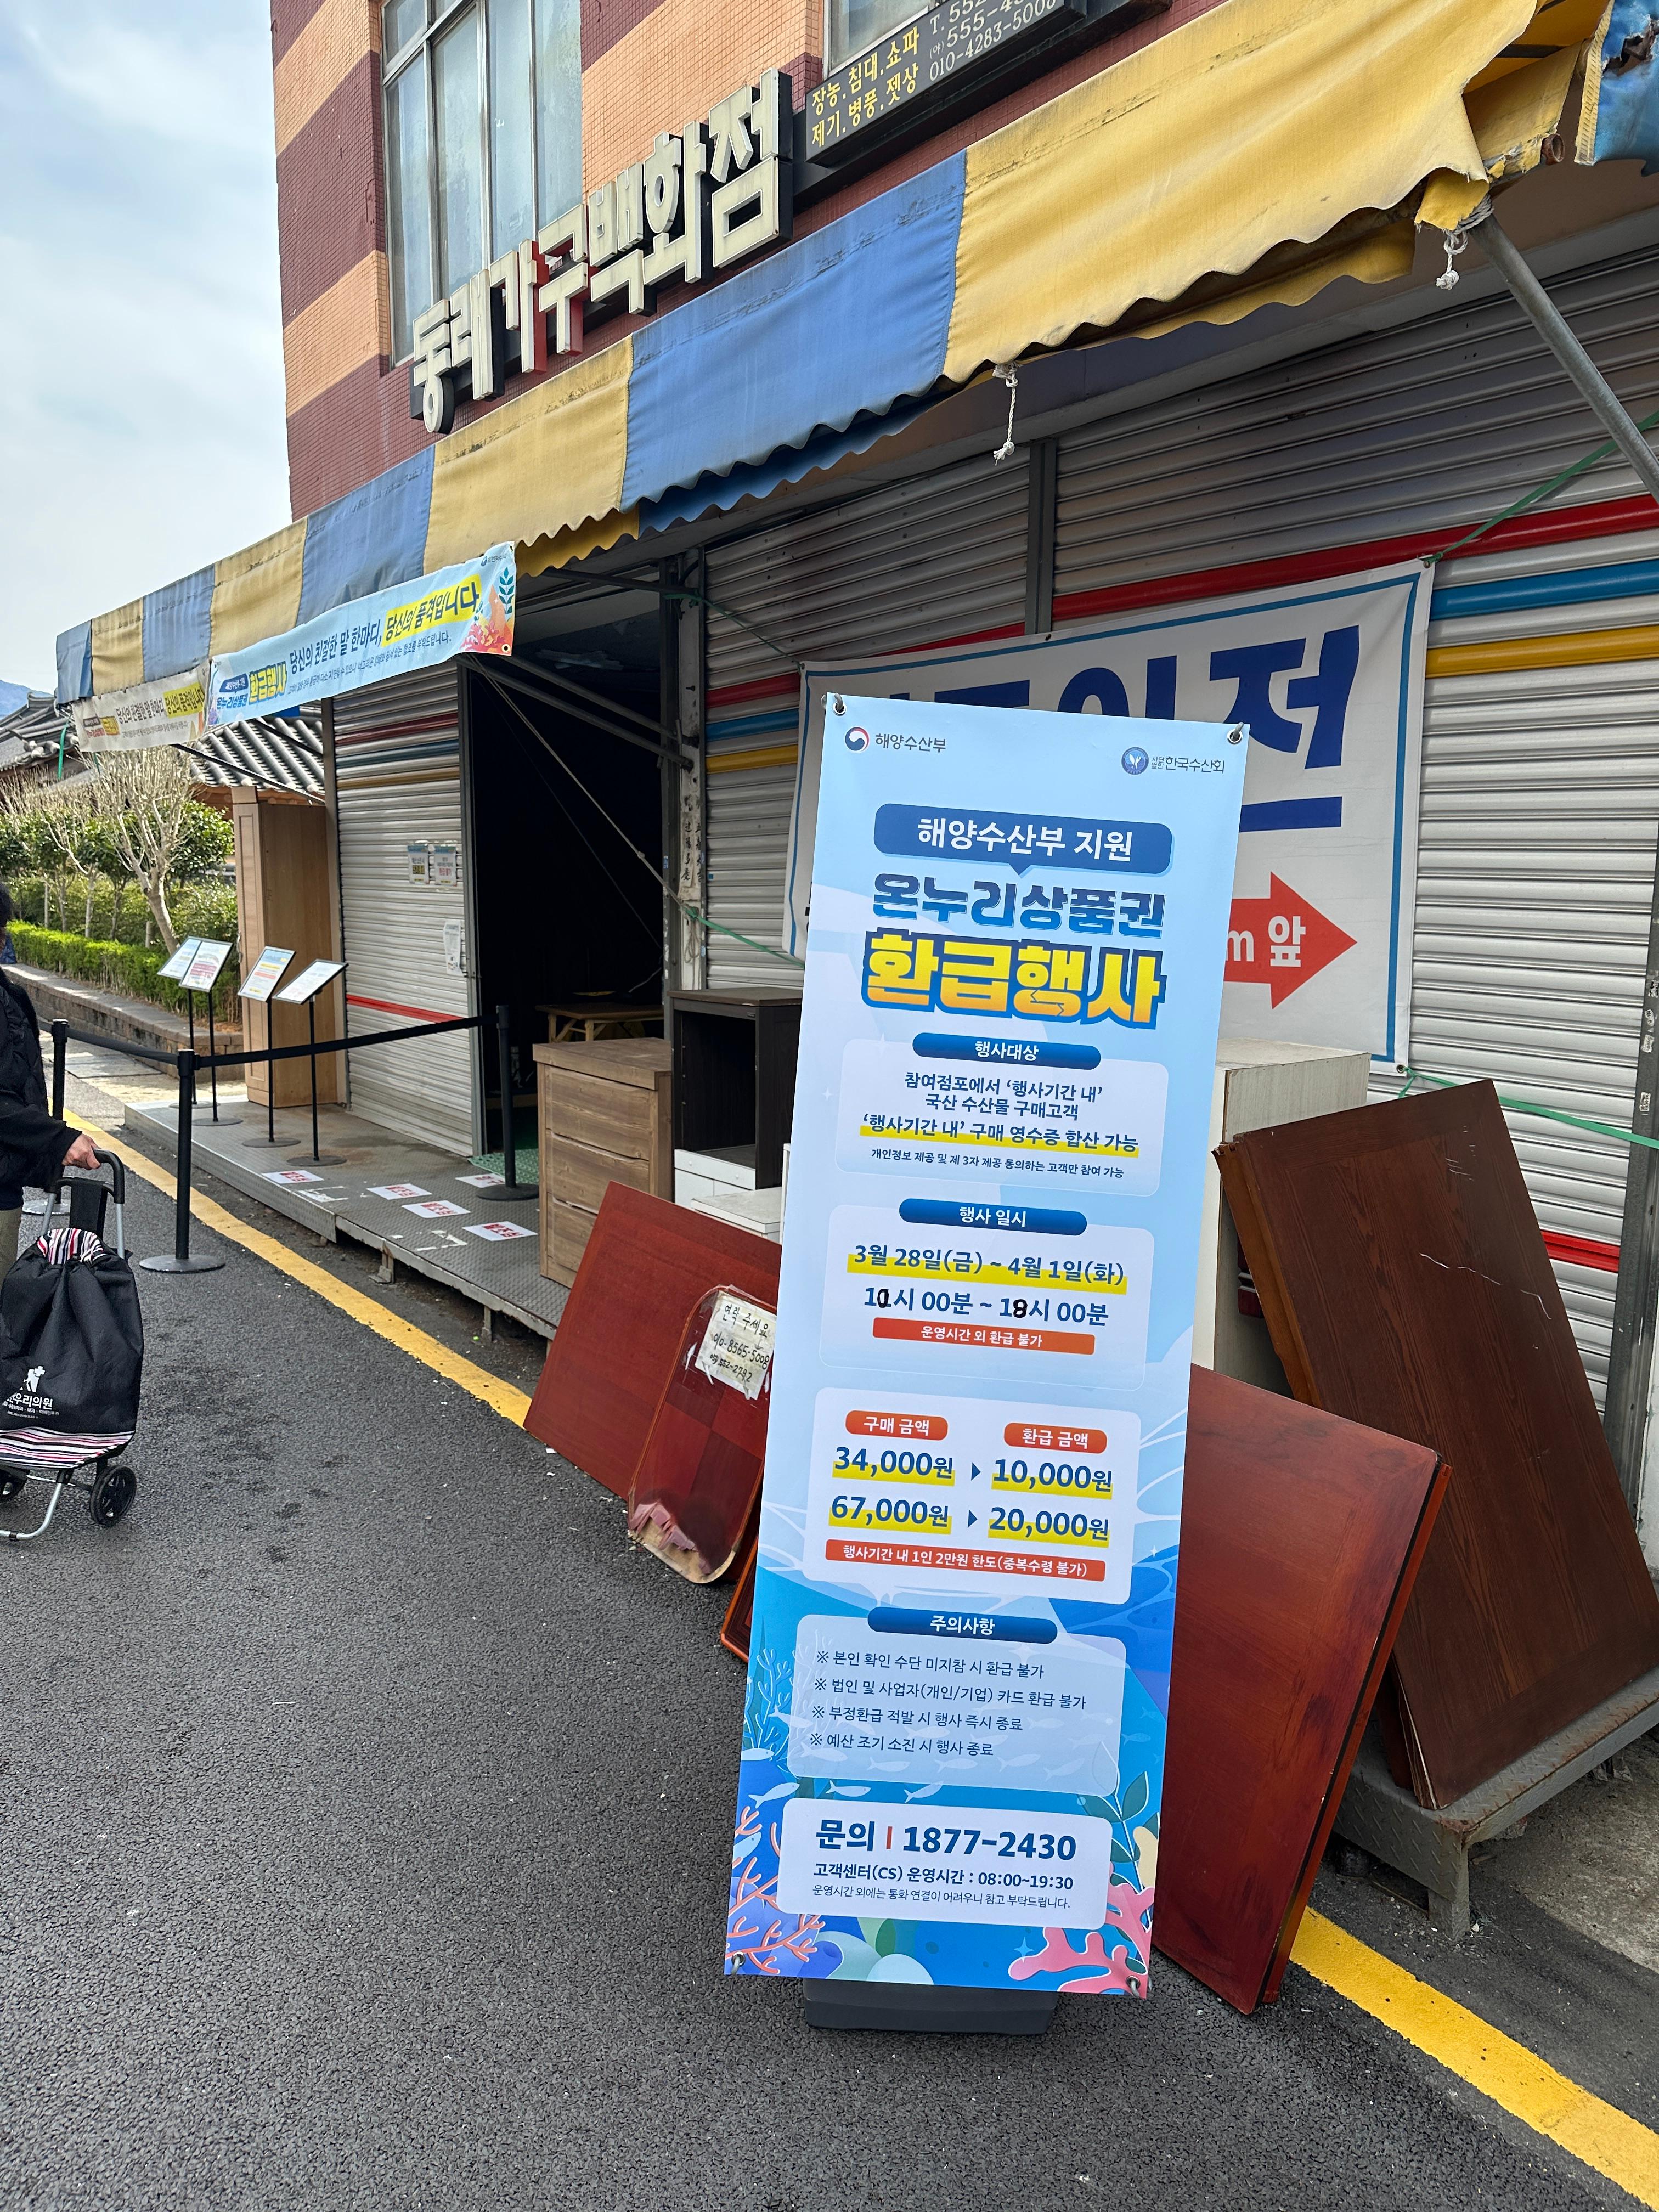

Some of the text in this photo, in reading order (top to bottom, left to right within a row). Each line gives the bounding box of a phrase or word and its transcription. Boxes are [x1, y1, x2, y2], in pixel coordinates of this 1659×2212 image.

[413, 67, 780, 433] 동래가구백화점
[290, 582, 480, 675] 당신의 친절한 말 한마디, 당신의 품격입니다
[249, 661, 288, 705] 환급행사
[875, 732, 947, 753] 해양수산부
[1165, 756, 1226, 774] 한국수산회
[917, 816, 1133, 862] 해양수산부 지원
[873, 872, 1166, 939] 온누리상품권
[1268, 915, 1306, 967] 앞
[864, 929, 1166, 1028] 환급행사
[975, 1041, 1039, 1062] 행사대상
[905, 1071, 1102, 1103] 참여점포에서 ‘행사기간 내’
[925, 1093, 1079, 1121] 국산 수산물 구매고객
[864, 1113, 1138, 1152] ‘행사기간 내’ 구매 영수증 합산 가능
[871, 1148, 1124, 1178] 개인정보 제공 및 제 3자 제공 동의하는 고객만 참여 가능
[960, 1206, 1026, 1227] 행사 일시
[854, 1245, 888, 1266] 3월
[894, 1248, 983, 1274] 28일(금)
[1008, 1257, 1042, 1279] 4월
[1048, 1260, 1124, 1285] 1일(화)
[723, 1304, 769, 1338] 연락 주세요
[922, 1291, 973, 1315] 00분
[999, 1298, 1049, 1322] 18시
[1057, 1302, 1109, 1327] 00분
[921, 1325, 1043, 1347] 운영시간 외 환급 불가
[864, 1416, 929, 1436] 구매 금액
[1022, 1428, 1088, 1449] 환급 금액
[835, 1446, 953, 1479] 34,000원
[994, 1459, 1112, 1492] 10,000원
[832, 1495, 949, 1527] 67,000원
[990, 1506, 1109, 1541] 20,000원
[843, 1545, 894, 1561] 행사기간
[896, 1549, 909, 1562] 내
[912, 1551, 932, 1564] 1인
[935, 1553, 968, 1567] 2만원
[1056, 1561, 1087, 1577] 불가)
[930, 1615, 995, 1635] 주의사항
[833, 1651, 860, 1666] 본인
[864, 1653, 890, 1668] 확인
[894, 1655, 922, 1671] 수단
[926, 1657, 966, 1673] 미지참
[969, 1660, 982, 1674] 시
[986, 1661, 1013, 1677] 환급
[1017, 1663, 1045, 1679] 불가
[832, 1678, 857, 1694] 법인
[862, 1680, 874, 1695] 및
[879, 1681, 993, 1703] 사업자(개인/기업)
[997, 1689, 1024, 1704] 카드
[1028, 1691, 1056, 1707] 환급
[1058, 1694, 1087, 1710] 불가
[828, 1706, 884, 1723] 부정환급
[887, 1709, 915, 1725] 적발
[917, 1712, 930, 1726] 시
[935, 1712, 962, 1728] 행사
[965, 1714, 991, 1730] 즉시
[995, 1717, 1023, 1731] 종료
[827, 1733, 855, 1748] 예산
[857, 1736, 884, 1751] 조기
[888, 1737, 915, 1752] 소진
[919, 1739, 932, 1753] 시
[936, 1740, 963, 1756] 행사
[966, 1742, 994, 1756] 종료
[816, 1819, 1076, 1861] 문의 1877-2430
[813, 1863, 903, 1882] 고객센터(CS)
[907, 1867, 965, 1885] 운영시간
[978, 1872, 1073, 1890] 08:00~19:30
[812, 1884, 1070, 1909] 운영시간 외에는 통화 연결이 어려우니 참고 부탁드립니다.
